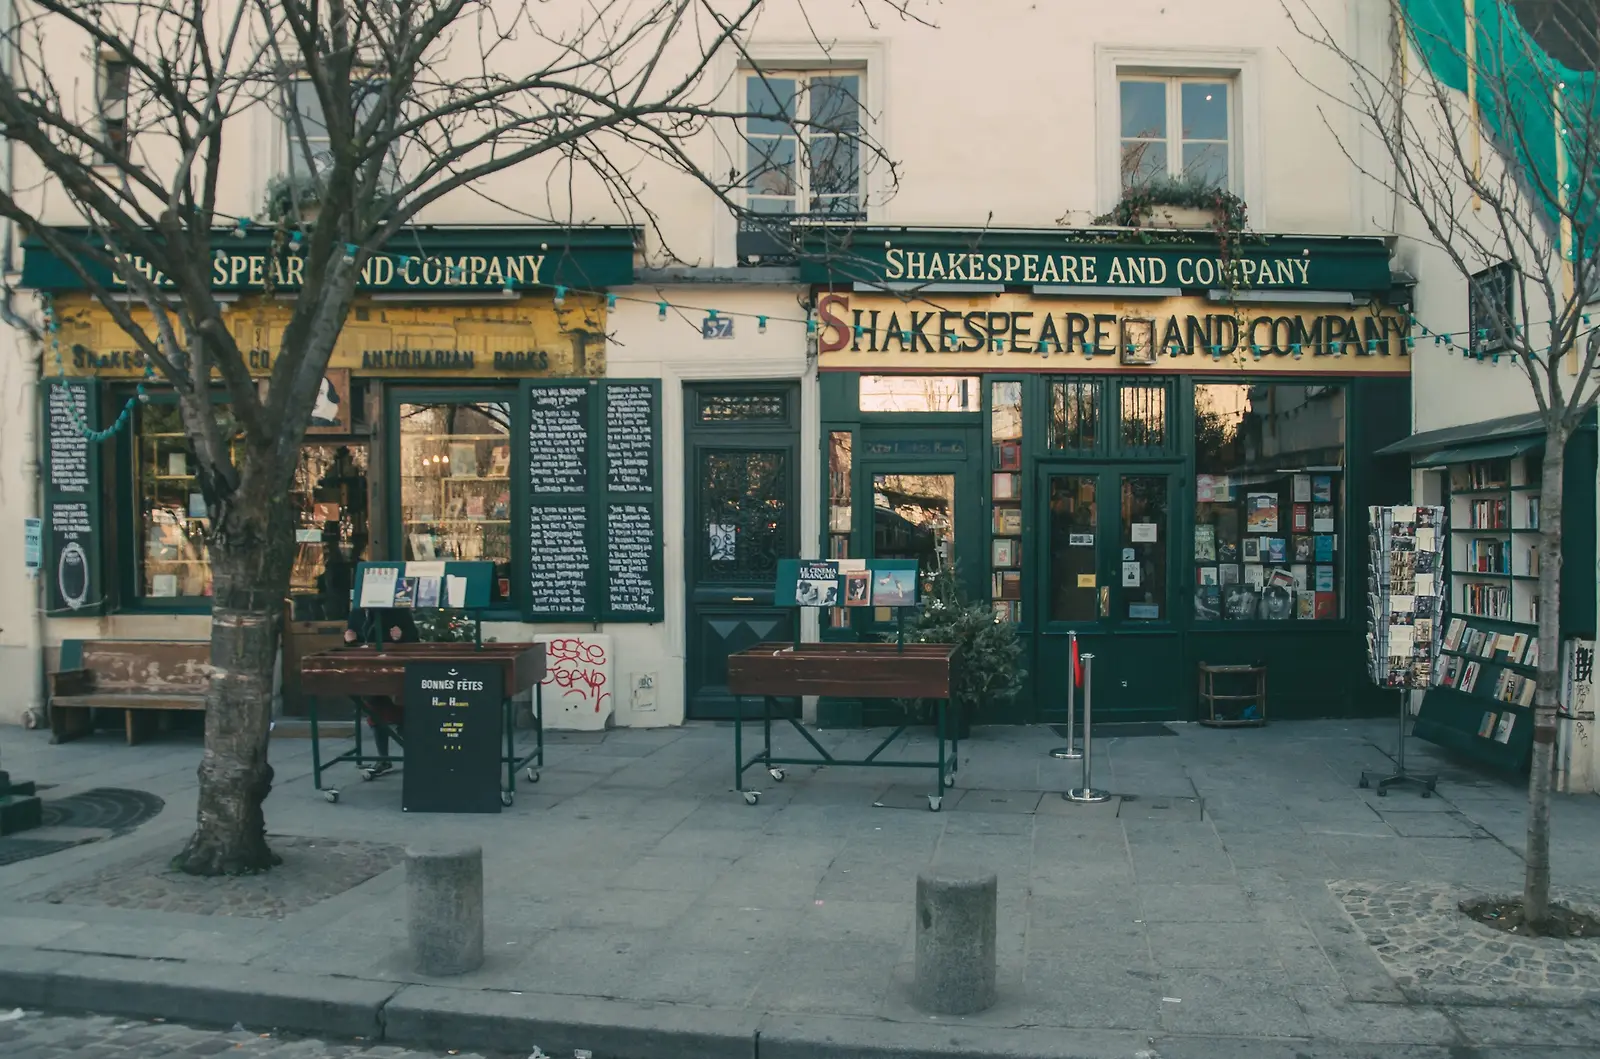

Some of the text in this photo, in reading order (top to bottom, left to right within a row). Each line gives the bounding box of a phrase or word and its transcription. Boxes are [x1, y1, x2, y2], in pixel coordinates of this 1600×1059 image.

[358, 256, 393, 285] ND
[404, 256, 545, 285] COMPANY
[885, 249, 1310, 285] SHAKESPEARE AND COMPANY
[818, 293, 1411, 357] SHAKESPEARE AND COMPANY
[362, 349, 549, 370] ANTIQUARIAN BOOKS
[421, 678, 484, 691] BONNES FÊTES
